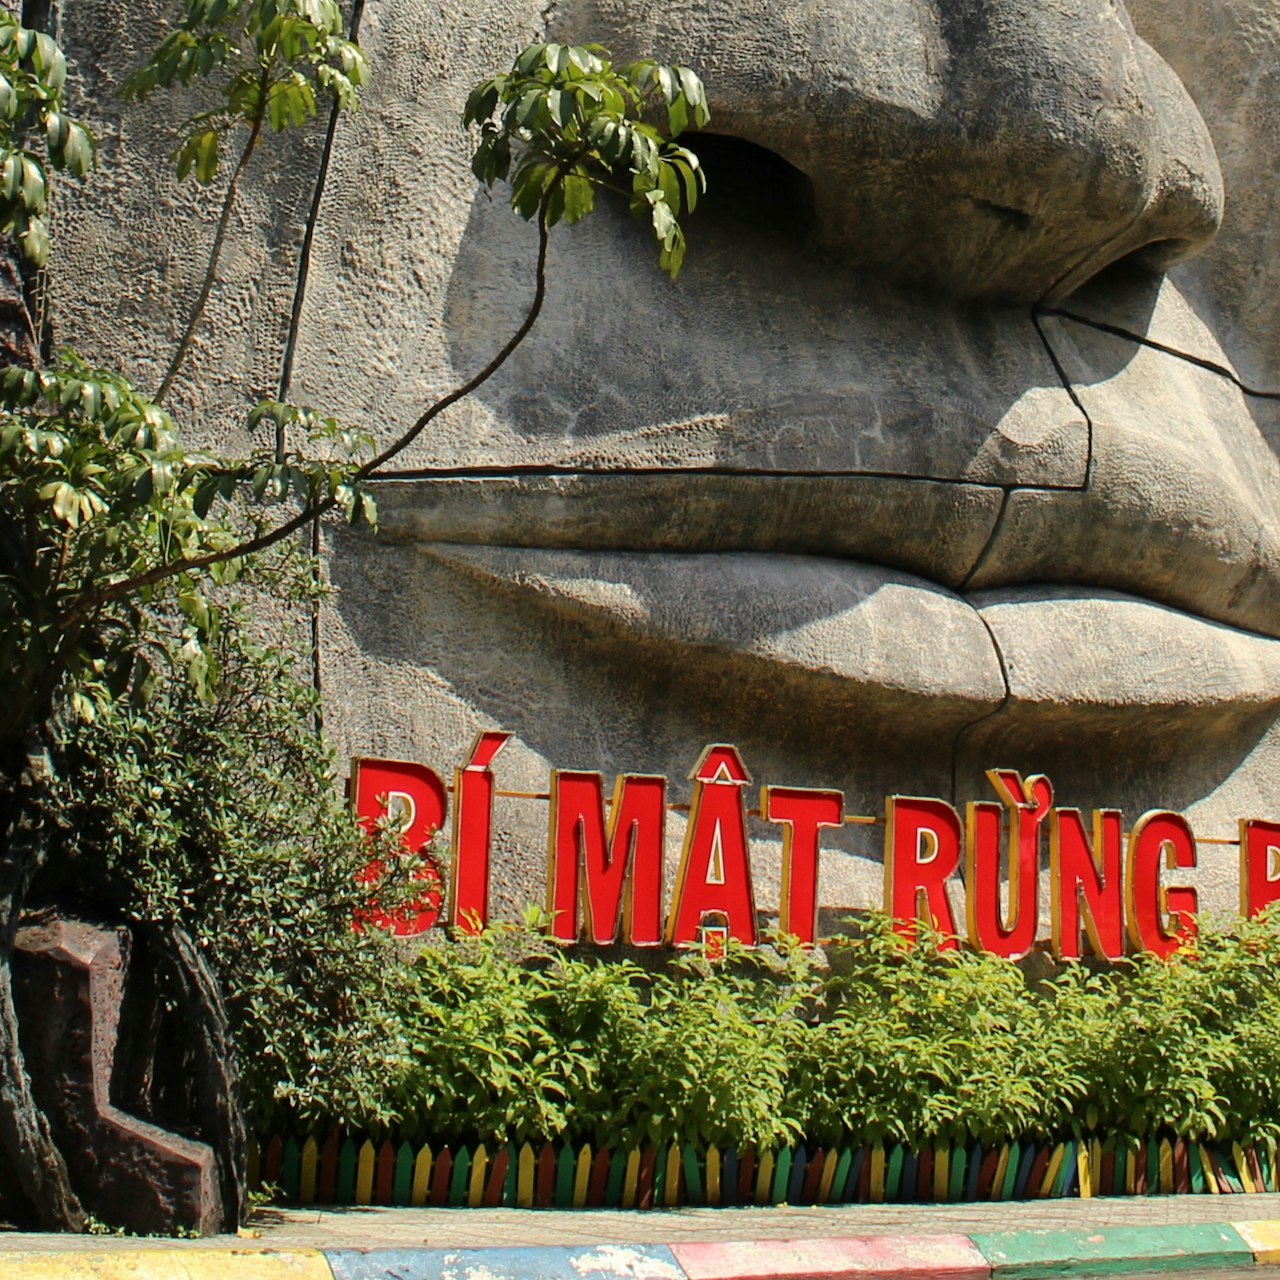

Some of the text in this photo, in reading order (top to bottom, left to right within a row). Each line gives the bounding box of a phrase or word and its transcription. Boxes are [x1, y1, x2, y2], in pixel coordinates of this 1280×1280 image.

[350, 730, 513, 938] BÍ
[549, 743, 845, 962] MẬT
[884, 768, 1198, 961] RỪNG
